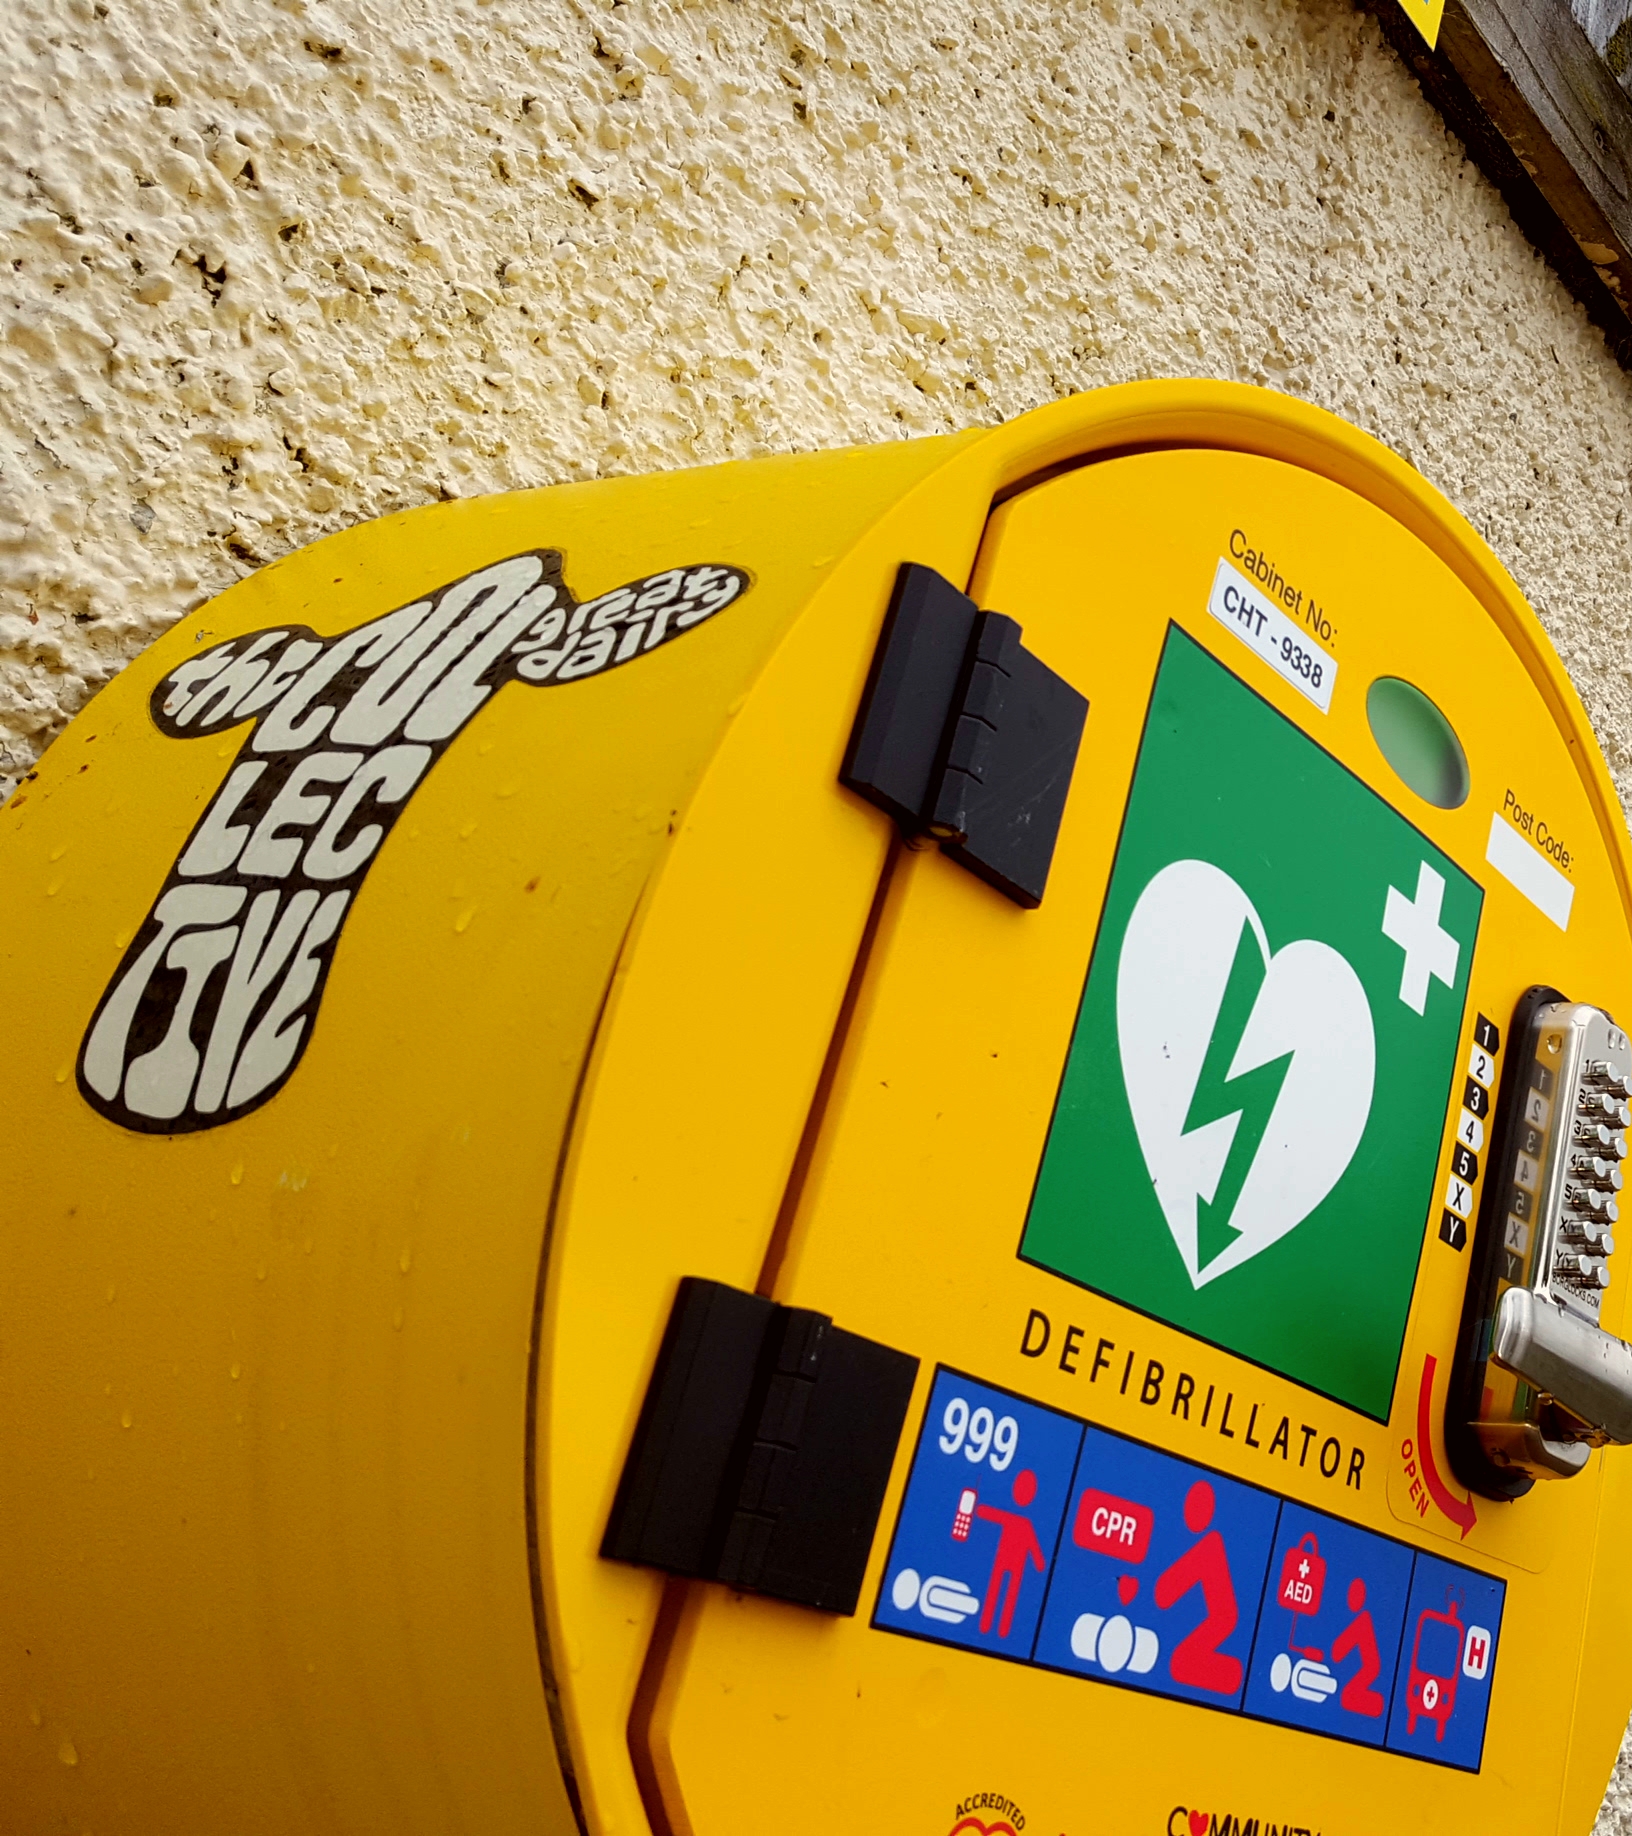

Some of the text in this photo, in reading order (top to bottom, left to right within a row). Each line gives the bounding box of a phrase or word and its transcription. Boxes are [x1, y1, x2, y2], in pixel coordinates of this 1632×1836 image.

[511, 567, 729, 654] great
[516, 575, 741, 681] dairy
[1229, 528, 1338, 649] Cabinet No:
[163, 630, 324, 728] the
[1223, 585, 1269, 638] CHT
[1280, 636, 1324, 689] 9338
[178, 743, 433, 881] LEC
[1503, 788, 1575, 874] Post Code:
[83, 882, 351, 1120] TIVE
[1449, 1024, 1491, 1243] 1 2 3 4 5 X Y
[938, 1396, 1019, 1471] 999
[1020, 1308, 1367, 1490] DEFIBRILLATOR
[1401, 1438, 1430, 1518] OPEN
[1091, 1506, 1137, 1548] CPR
[1284, 1579, 1313, 1605] AED
[1467, 1636, 1486, 1670] H
[956, 1792, 1026, 1831] ACCREDITED
